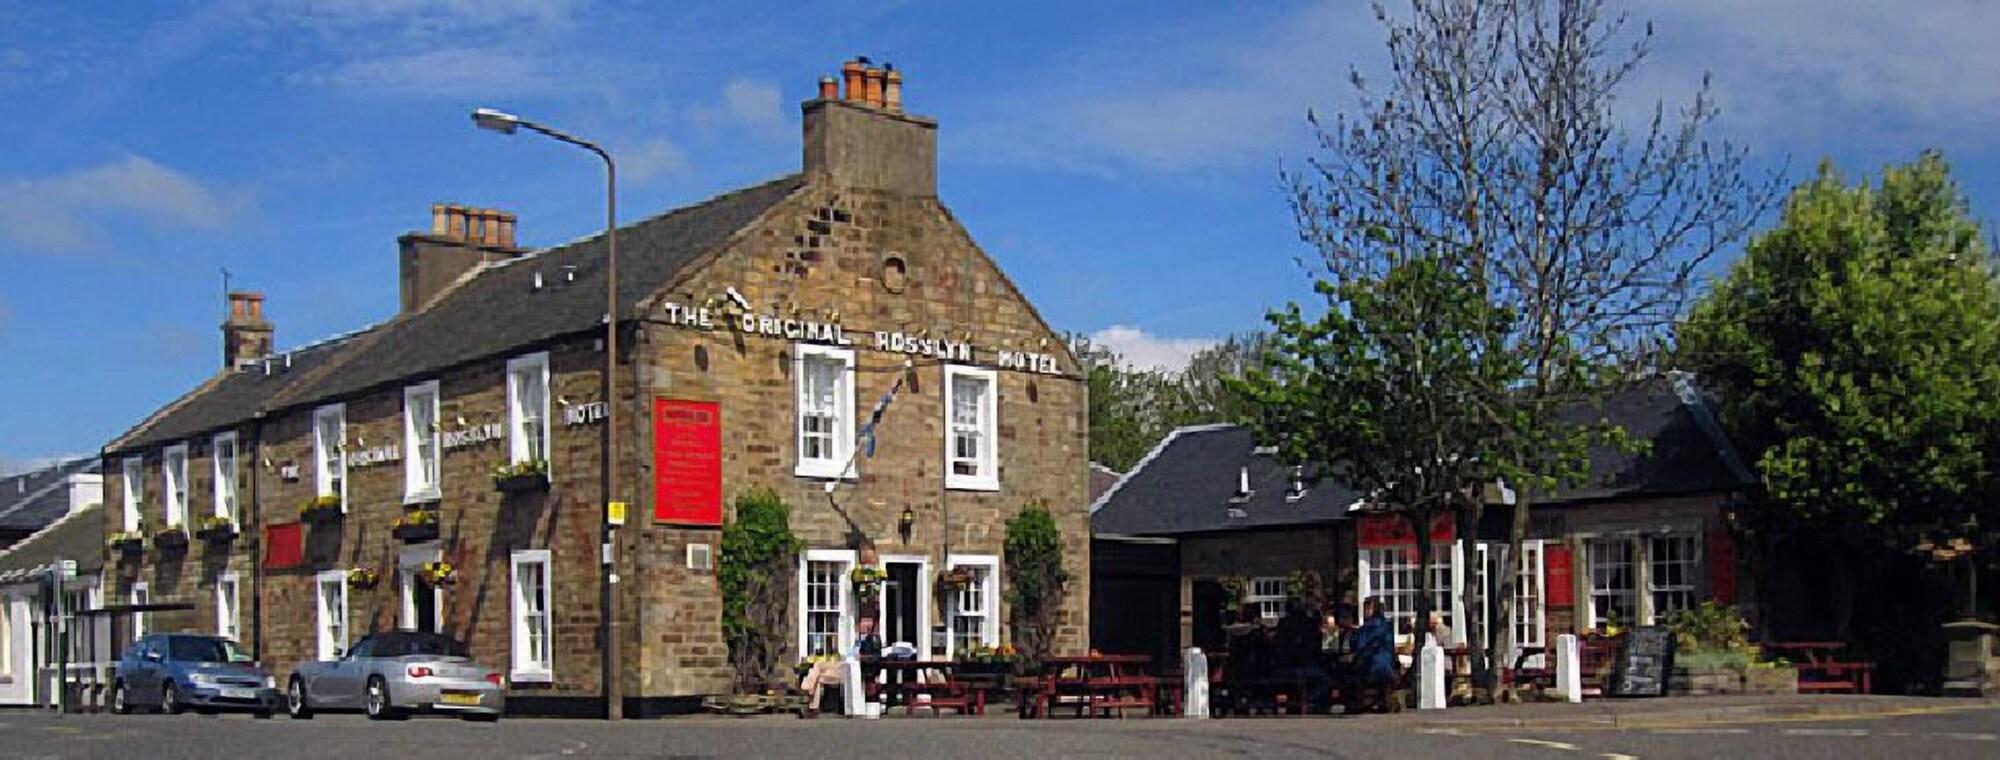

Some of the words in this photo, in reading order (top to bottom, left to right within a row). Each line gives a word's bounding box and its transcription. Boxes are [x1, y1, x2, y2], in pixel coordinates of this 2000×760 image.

[665, 302, 713, 326] THE
[742, 312, 851, 345] ORIGINAL
[875, 331, 970, 360] ROSSLYN
[998, 350, 1062, 375] HOTEL
